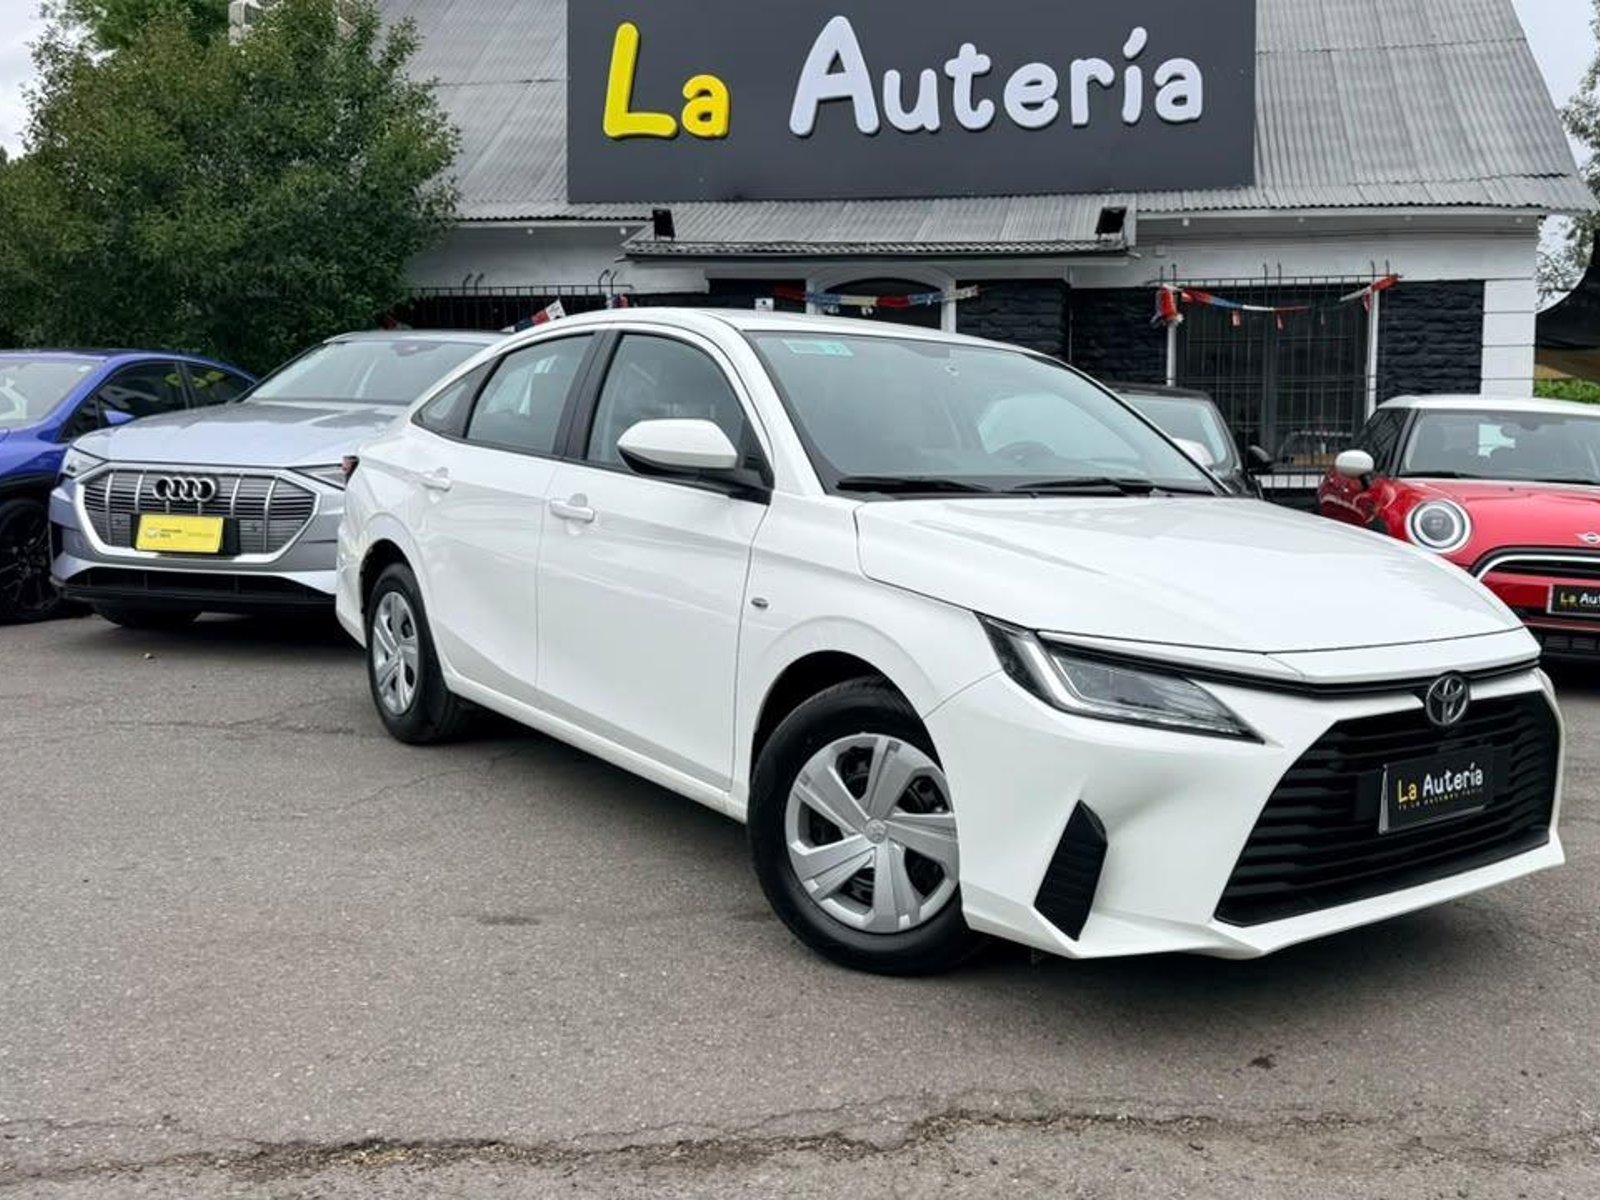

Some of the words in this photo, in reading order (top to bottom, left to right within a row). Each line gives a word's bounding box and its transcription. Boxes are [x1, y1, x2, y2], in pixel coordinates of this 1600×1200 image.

[602, 22, 731, 139] La
[788, 15, 1204, 135] Autería
[1397, 779, 1418, 803] La
[1423, 762, 1483, 798] Autería
